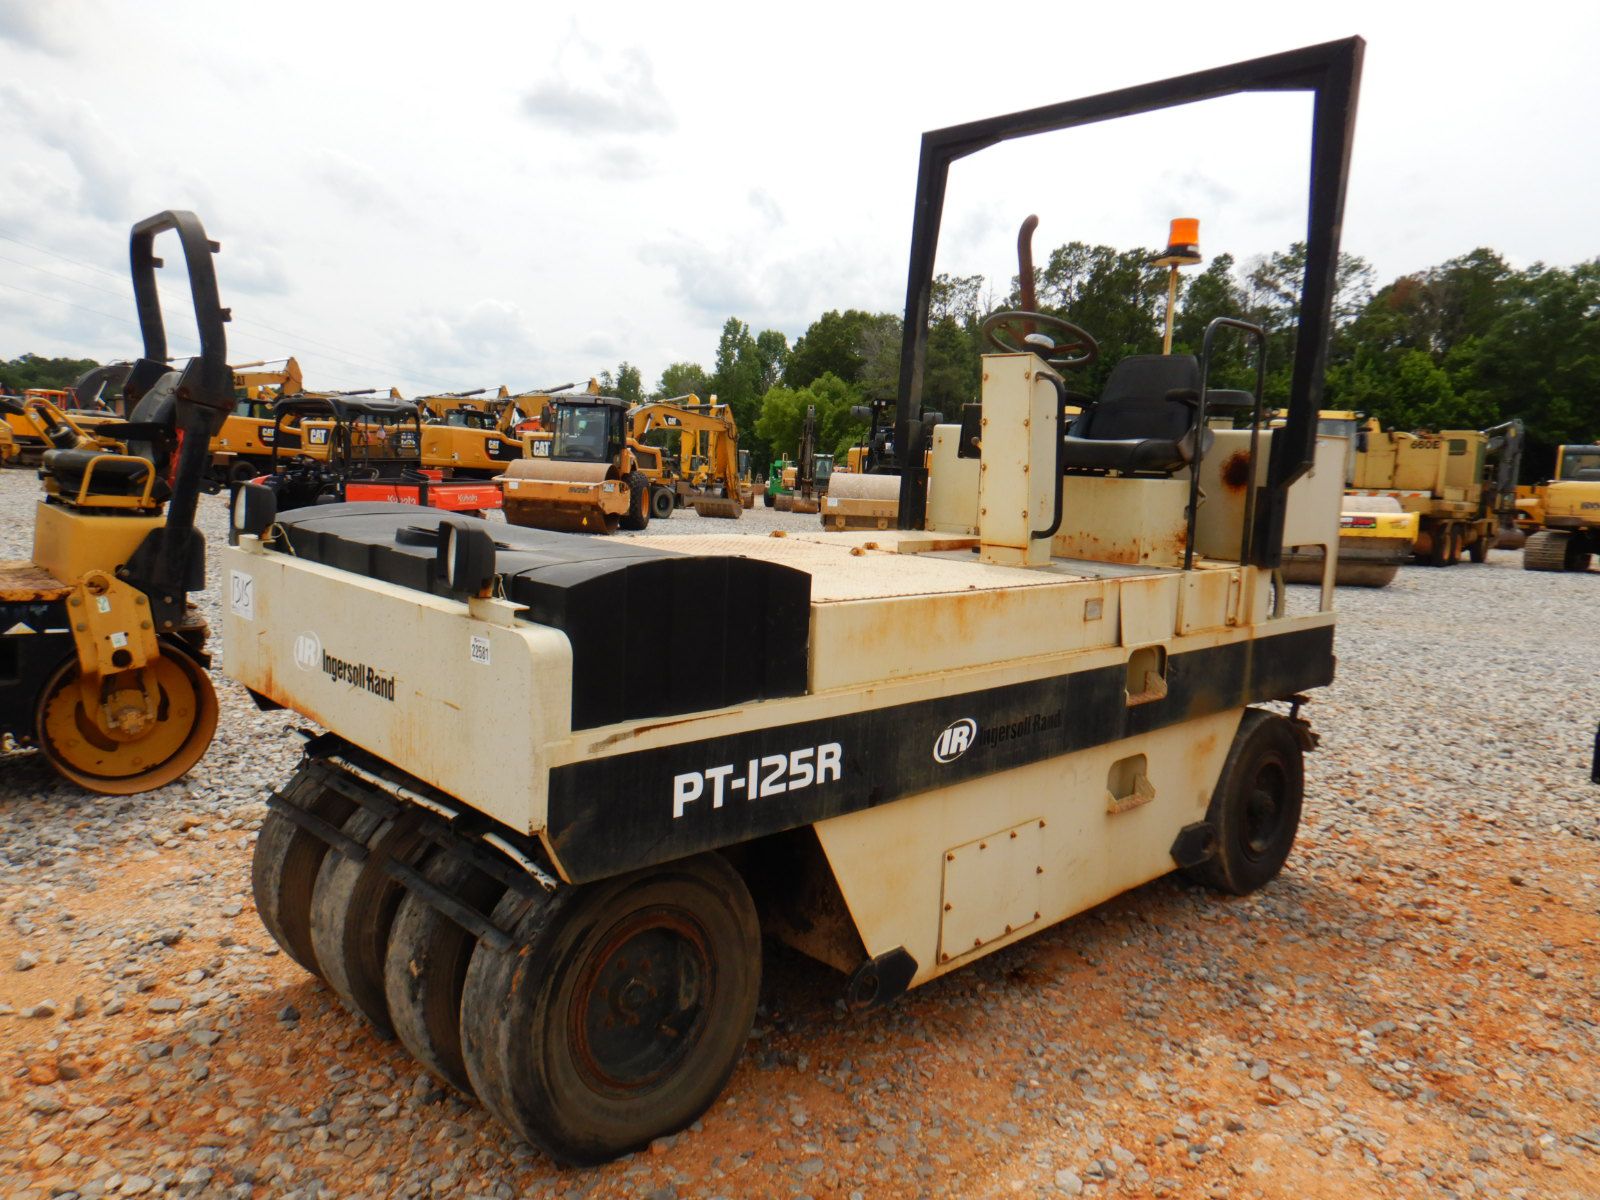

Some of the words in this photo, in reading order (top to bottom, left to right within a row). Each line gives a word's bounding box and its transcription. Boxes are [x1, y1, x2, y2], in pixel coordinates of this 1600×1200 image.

[310, 429, 326, 444] CAT
[488, 440, 500, 449] CAT
[534, 441, 550, 457] CAT
[673, 742, 842, 819] PT-125R
